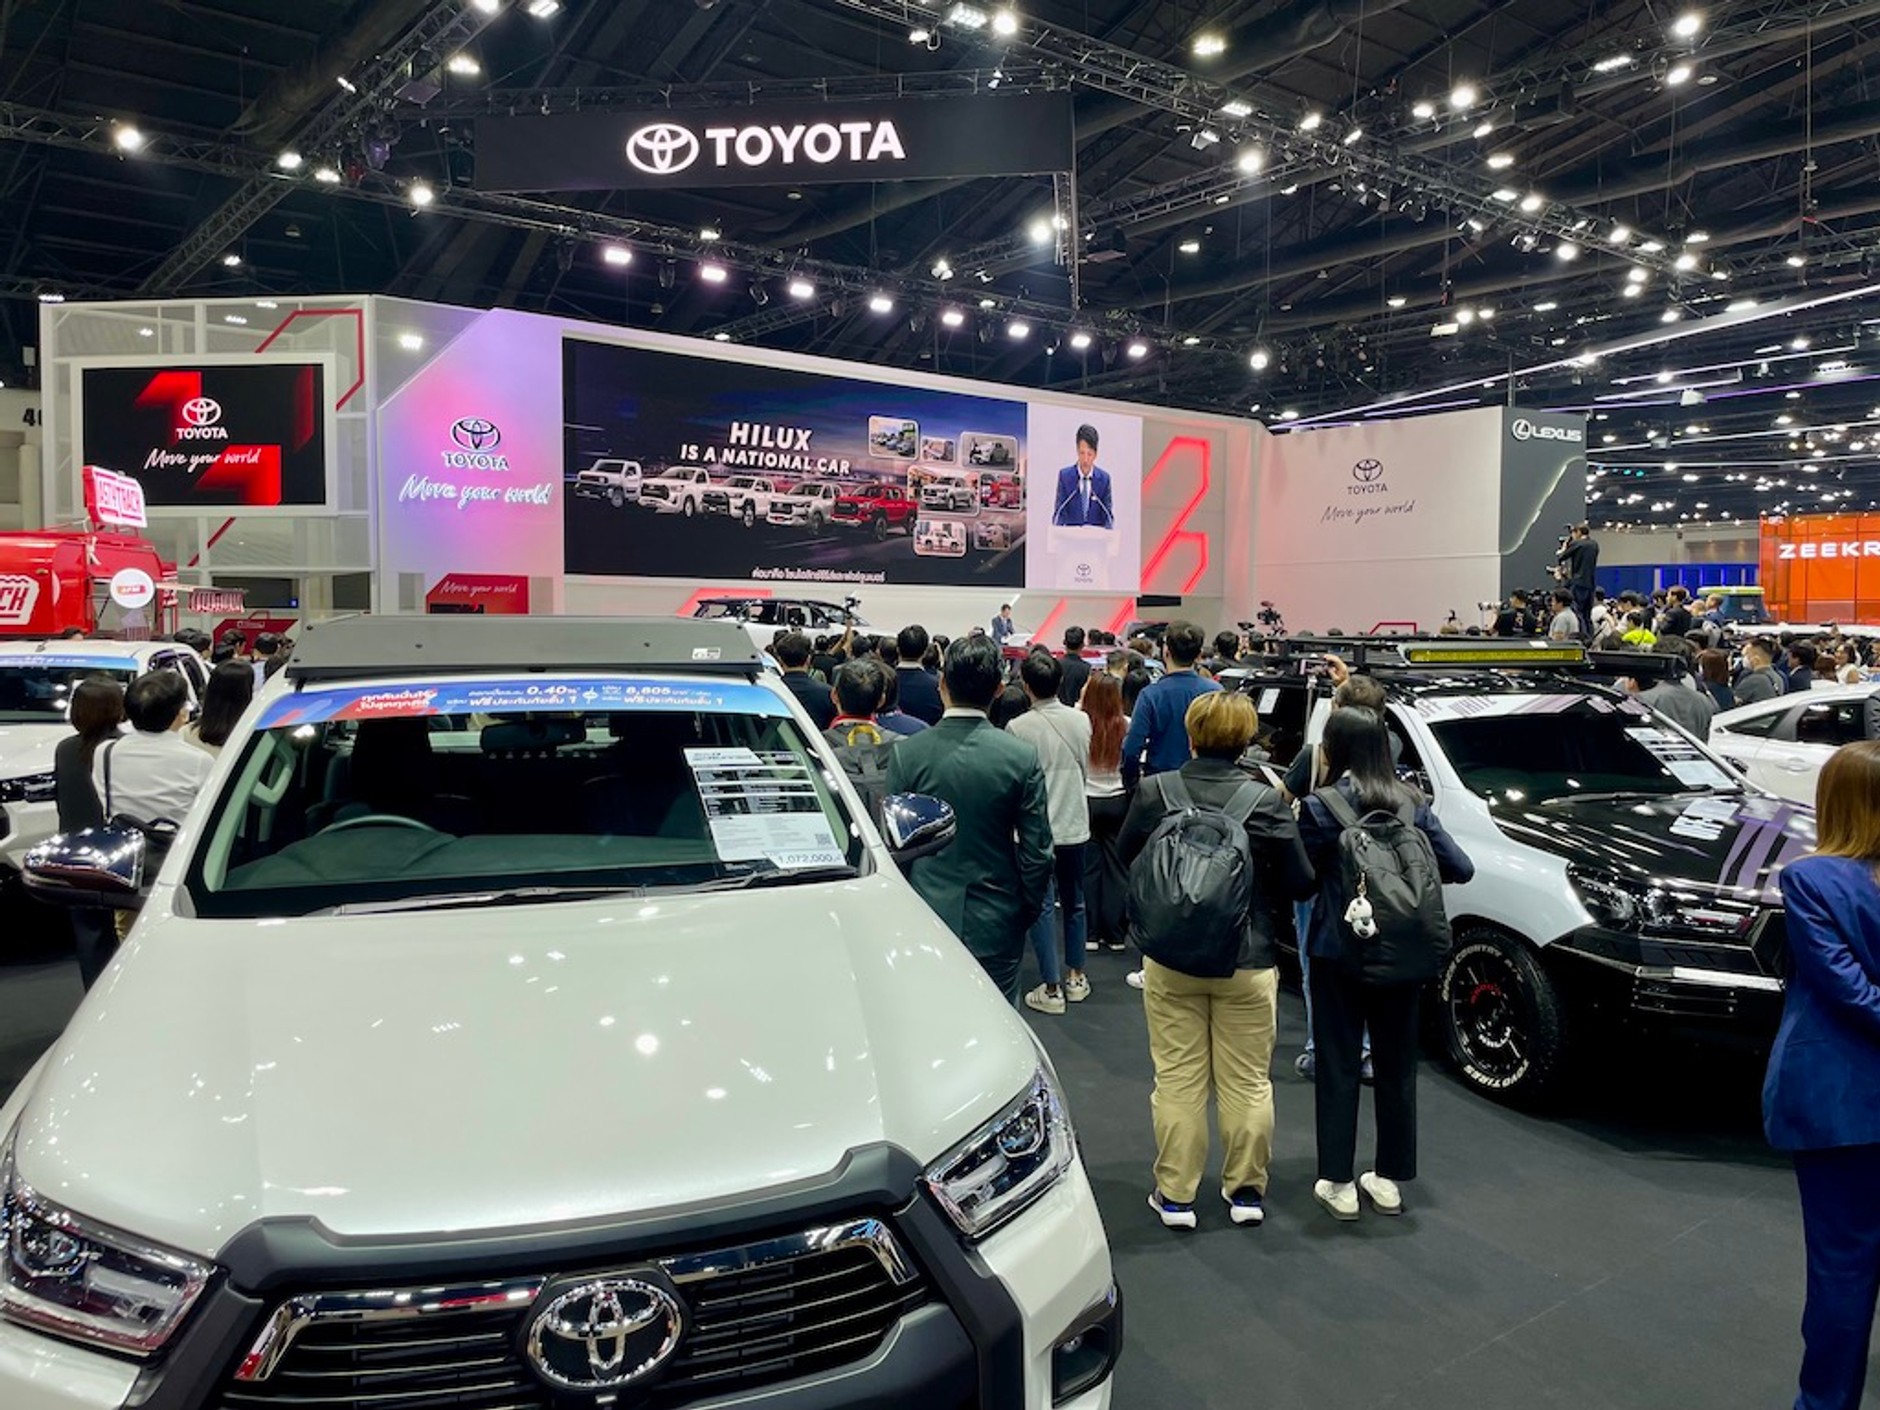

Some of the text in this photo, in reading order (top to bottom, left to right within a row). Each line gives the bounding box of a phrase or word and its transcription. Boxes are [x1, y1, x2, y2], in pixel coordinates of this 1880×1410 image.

[705, 120, 906, 167] TOYOTA
[22, 407, 42, 427] 4
[175, 427, 229, 440] TOYOTA
[729, 421, 813, 451] HILUX
[1532, 426, 1582, 442] LEXUS
[143, 447, 262, 473] Move your world
[441, 451, 510, 471] TOYOTA
[680, 444, 851, 474] IS A NATIONAL CAR
[398, 473, 553, 510] Move your world
[1347, 483, 1388, 495] TOYOTA
[1320, 499, 1416, 524] Move your world
[1779, 541, 1880, 559] ZEEKR
[440, 580, 518, 598] Move your world
[1463, 1064, 1501, 1088] TIRES
